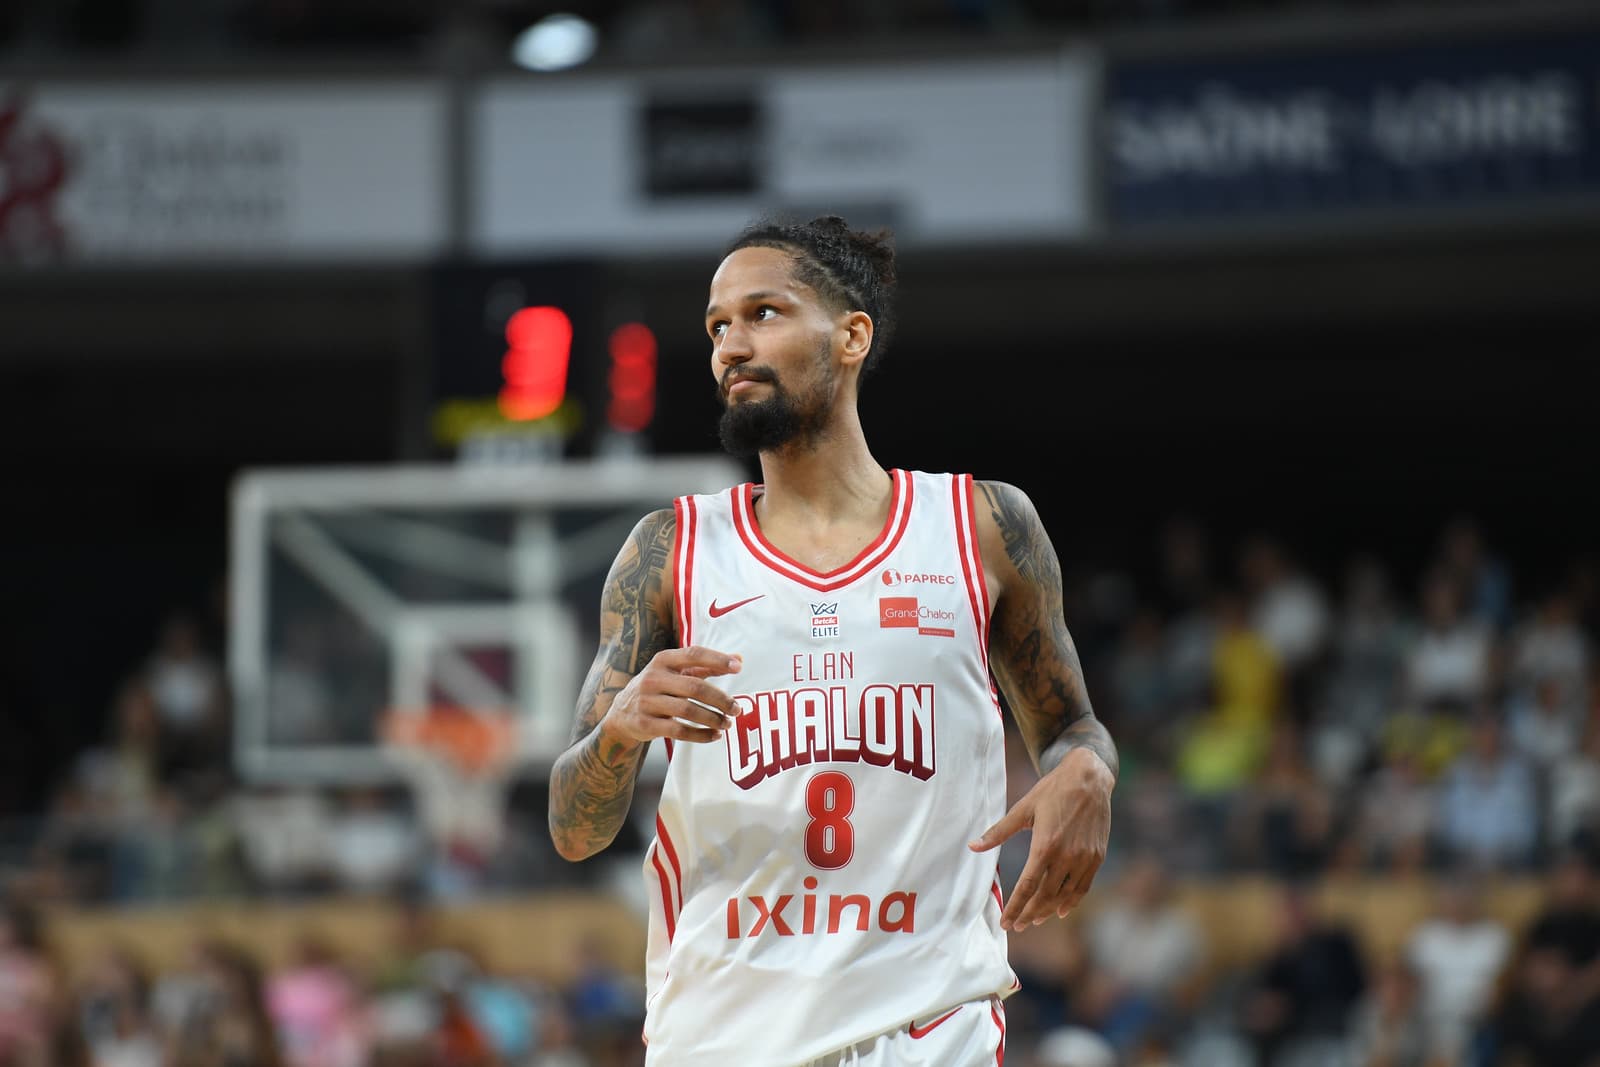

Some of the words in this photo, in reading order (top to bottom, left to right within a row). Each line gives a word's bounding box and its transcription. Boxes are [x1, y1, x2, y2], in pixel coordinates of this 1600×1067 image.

[904, 574, 955, 585] PAPREC
[793, 652, 853, 682] ELAN
[726, 684, 935, 790] CHALON
[804, 771, 855, 870] 8
[727, 876, 917, 939] ixina
